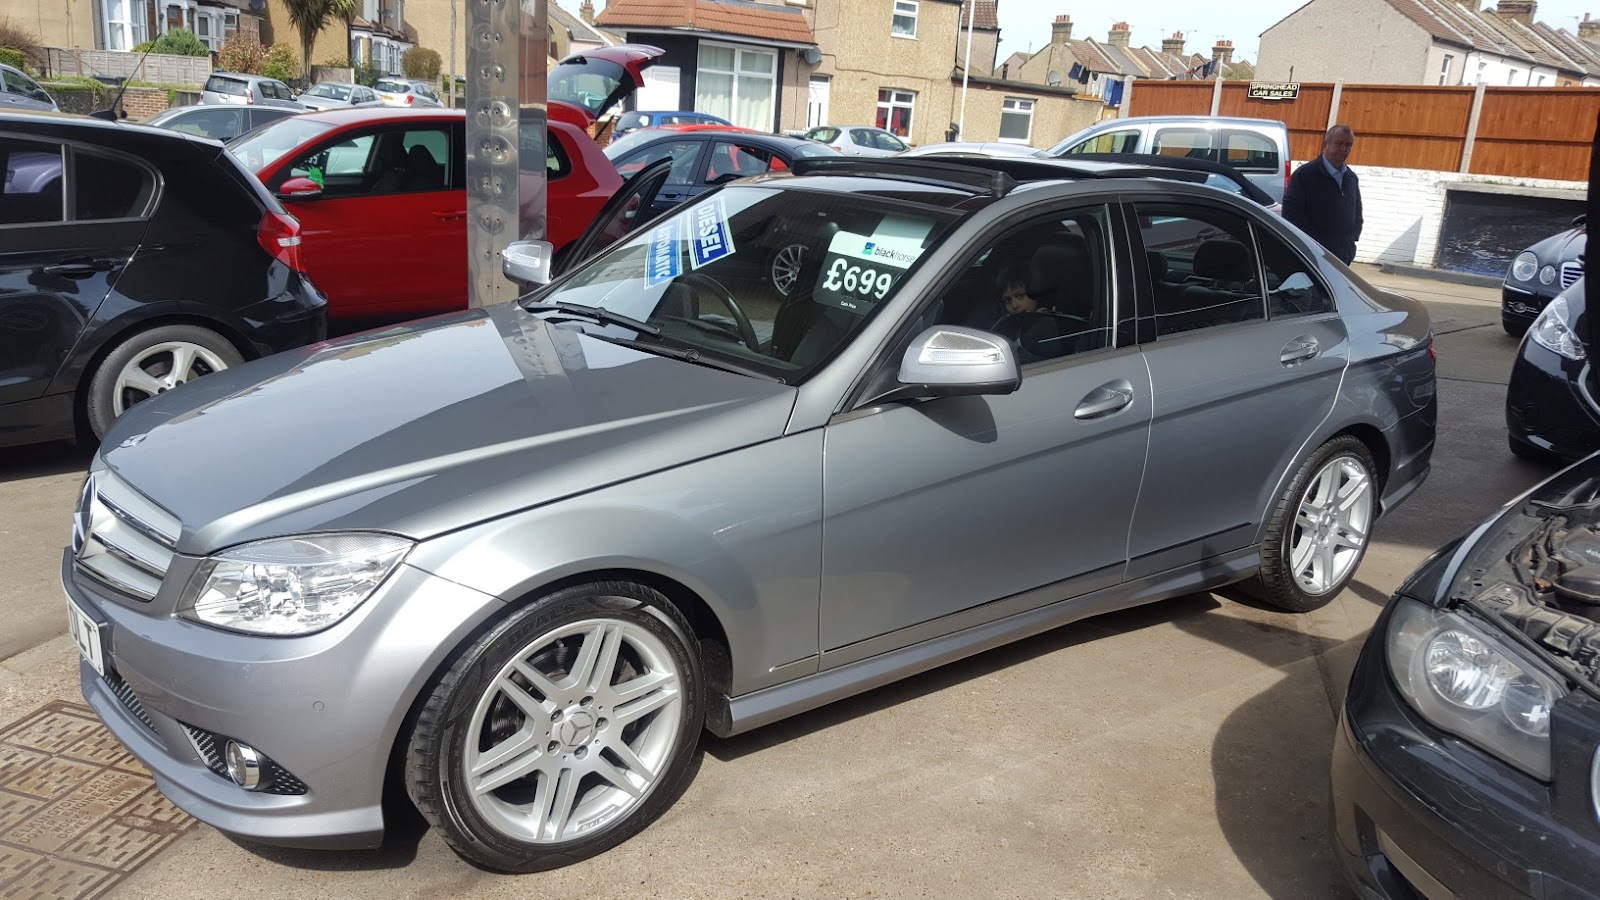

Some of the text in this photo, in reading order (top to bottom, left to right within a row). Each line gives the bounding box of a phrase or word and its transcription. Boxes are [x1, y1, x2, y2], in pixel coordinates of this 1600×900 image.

[654, 224, 673, 280] AUTOMATIC
[697, 203, 722, 259] DIESEL
[874, 246, 916, 264] blackhorse
[822, 258, 892, 300] £699
